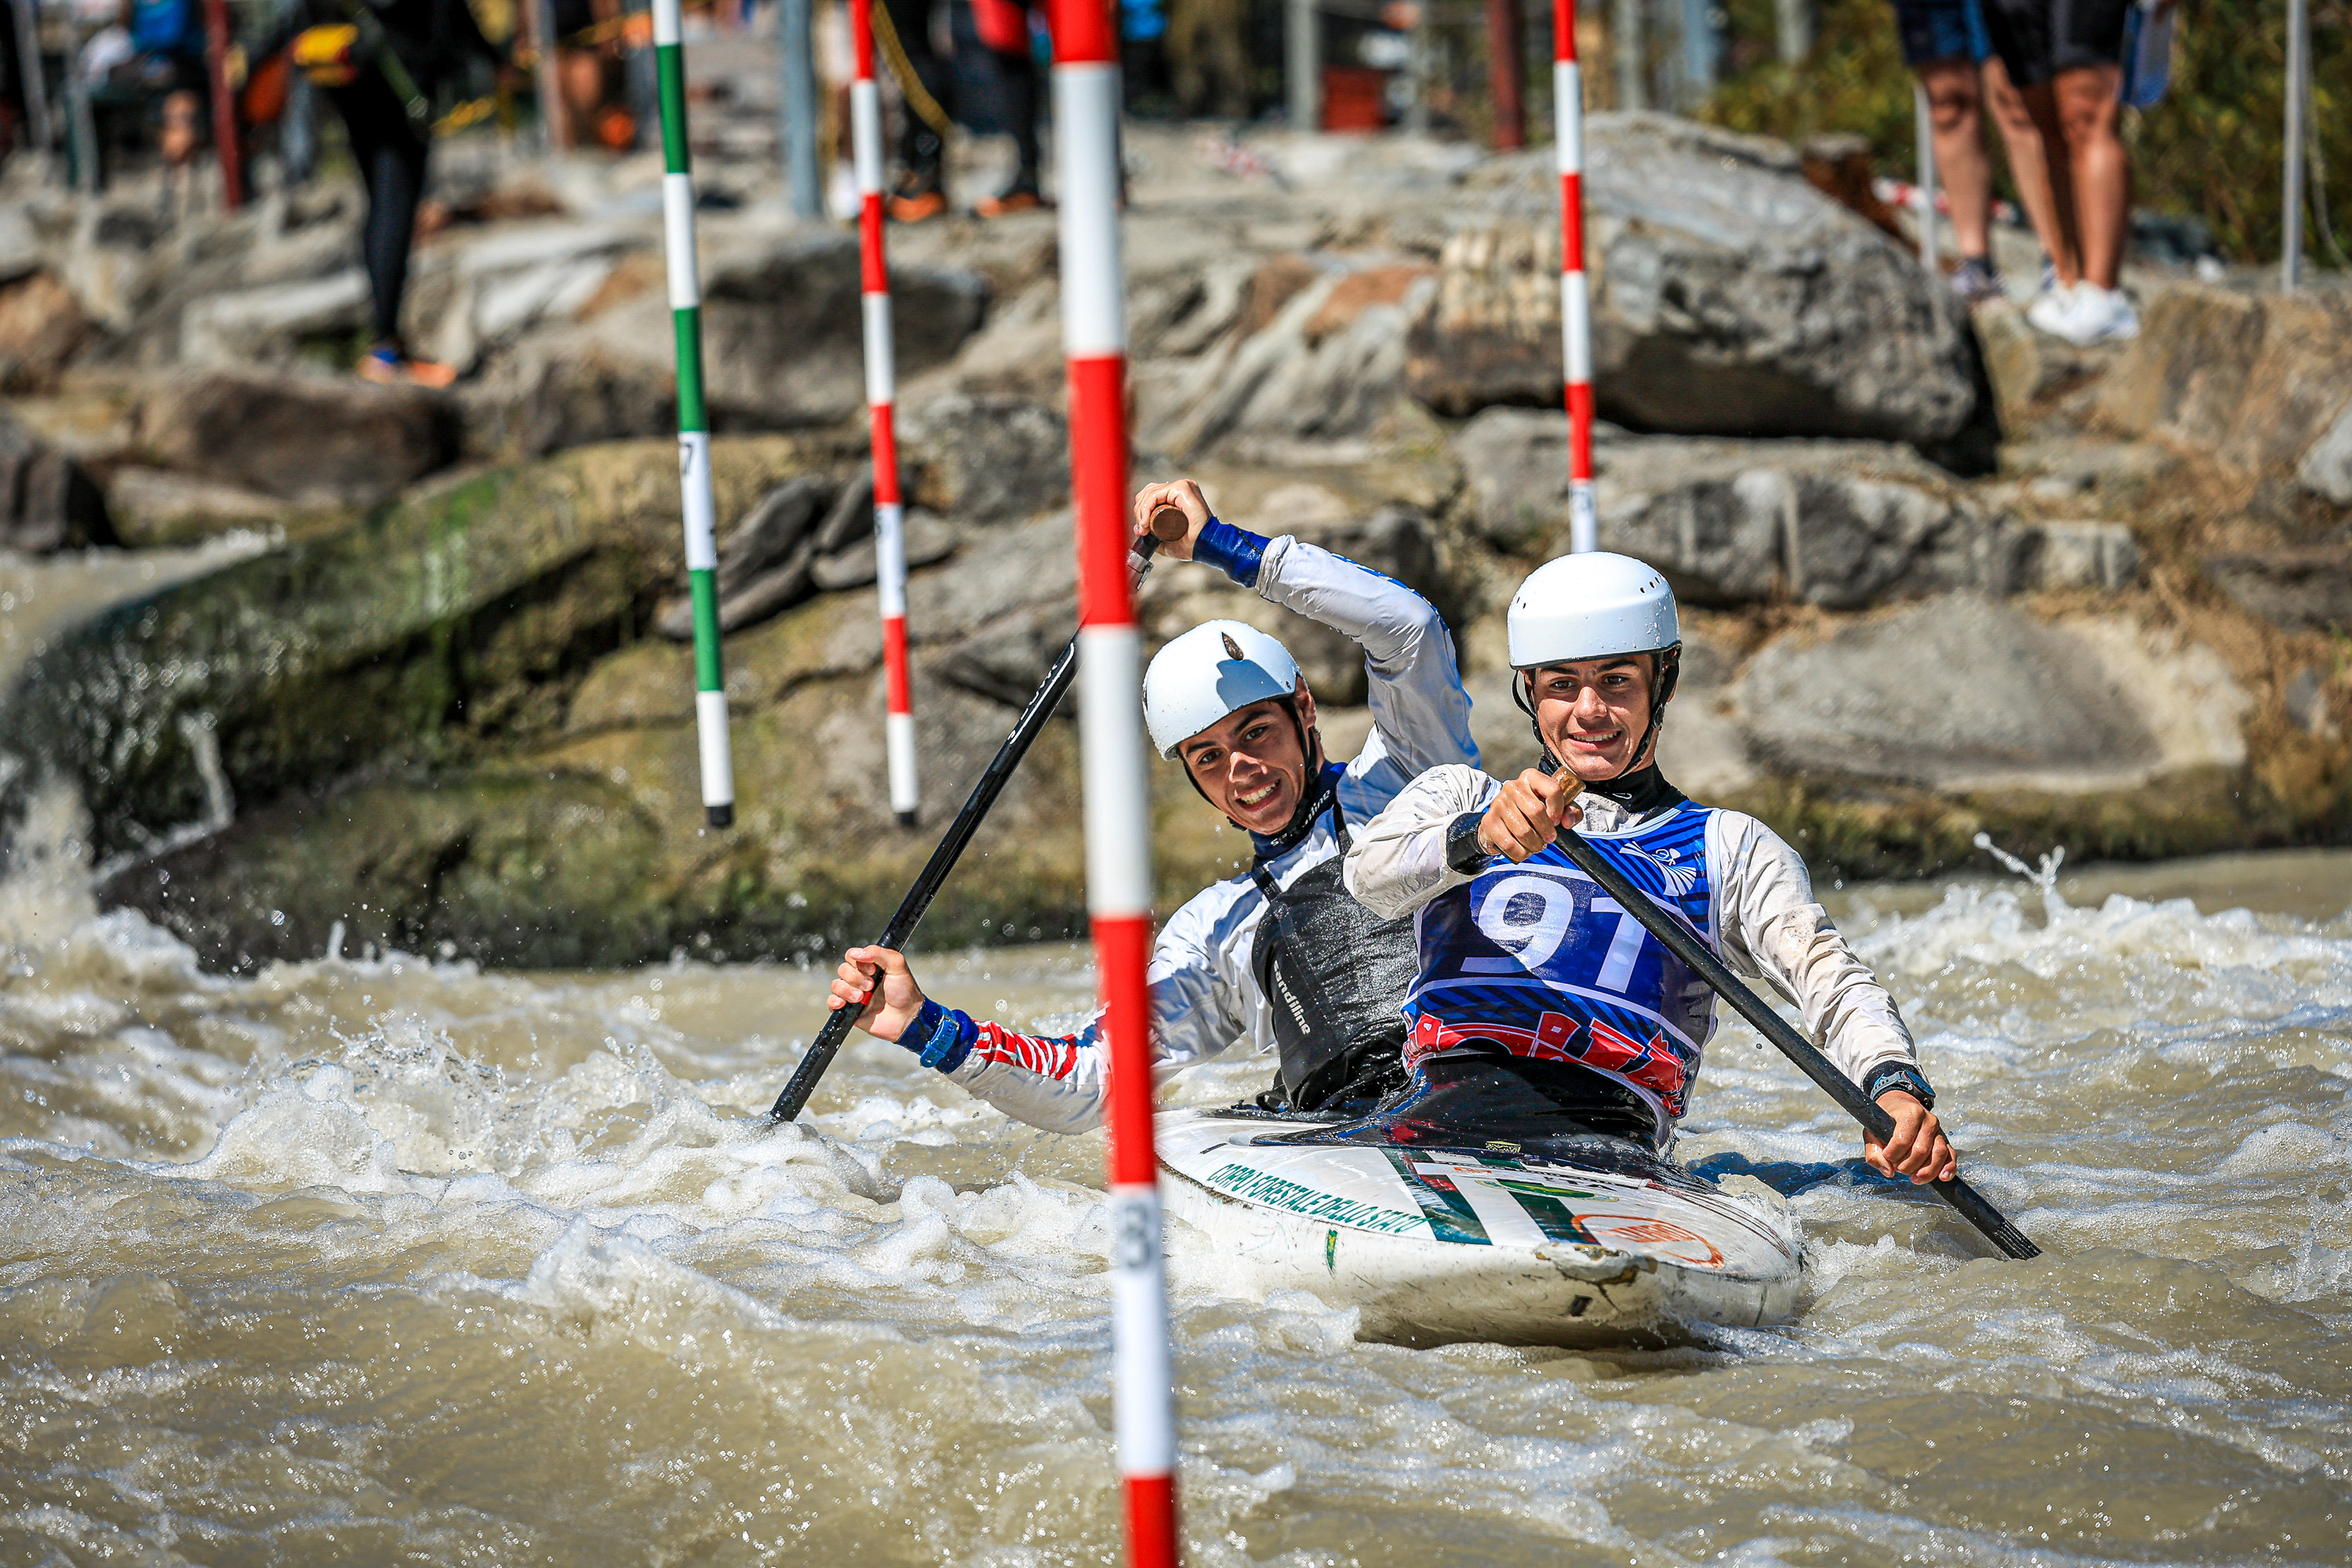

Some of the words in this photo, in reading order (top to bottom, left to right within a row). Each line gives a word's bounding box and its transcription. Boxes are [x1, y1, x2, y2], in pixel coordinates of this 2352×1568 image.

[1273, 960, 1311, 1035] sandiline
[1207, 1163, 1263, 1192] CORPO
[1240, 1174, 1333, 1213] FORESTALE
[1308, 1196, 1378, 1223] DELLO
[1357, 1209, 1432, 1233] STATO
